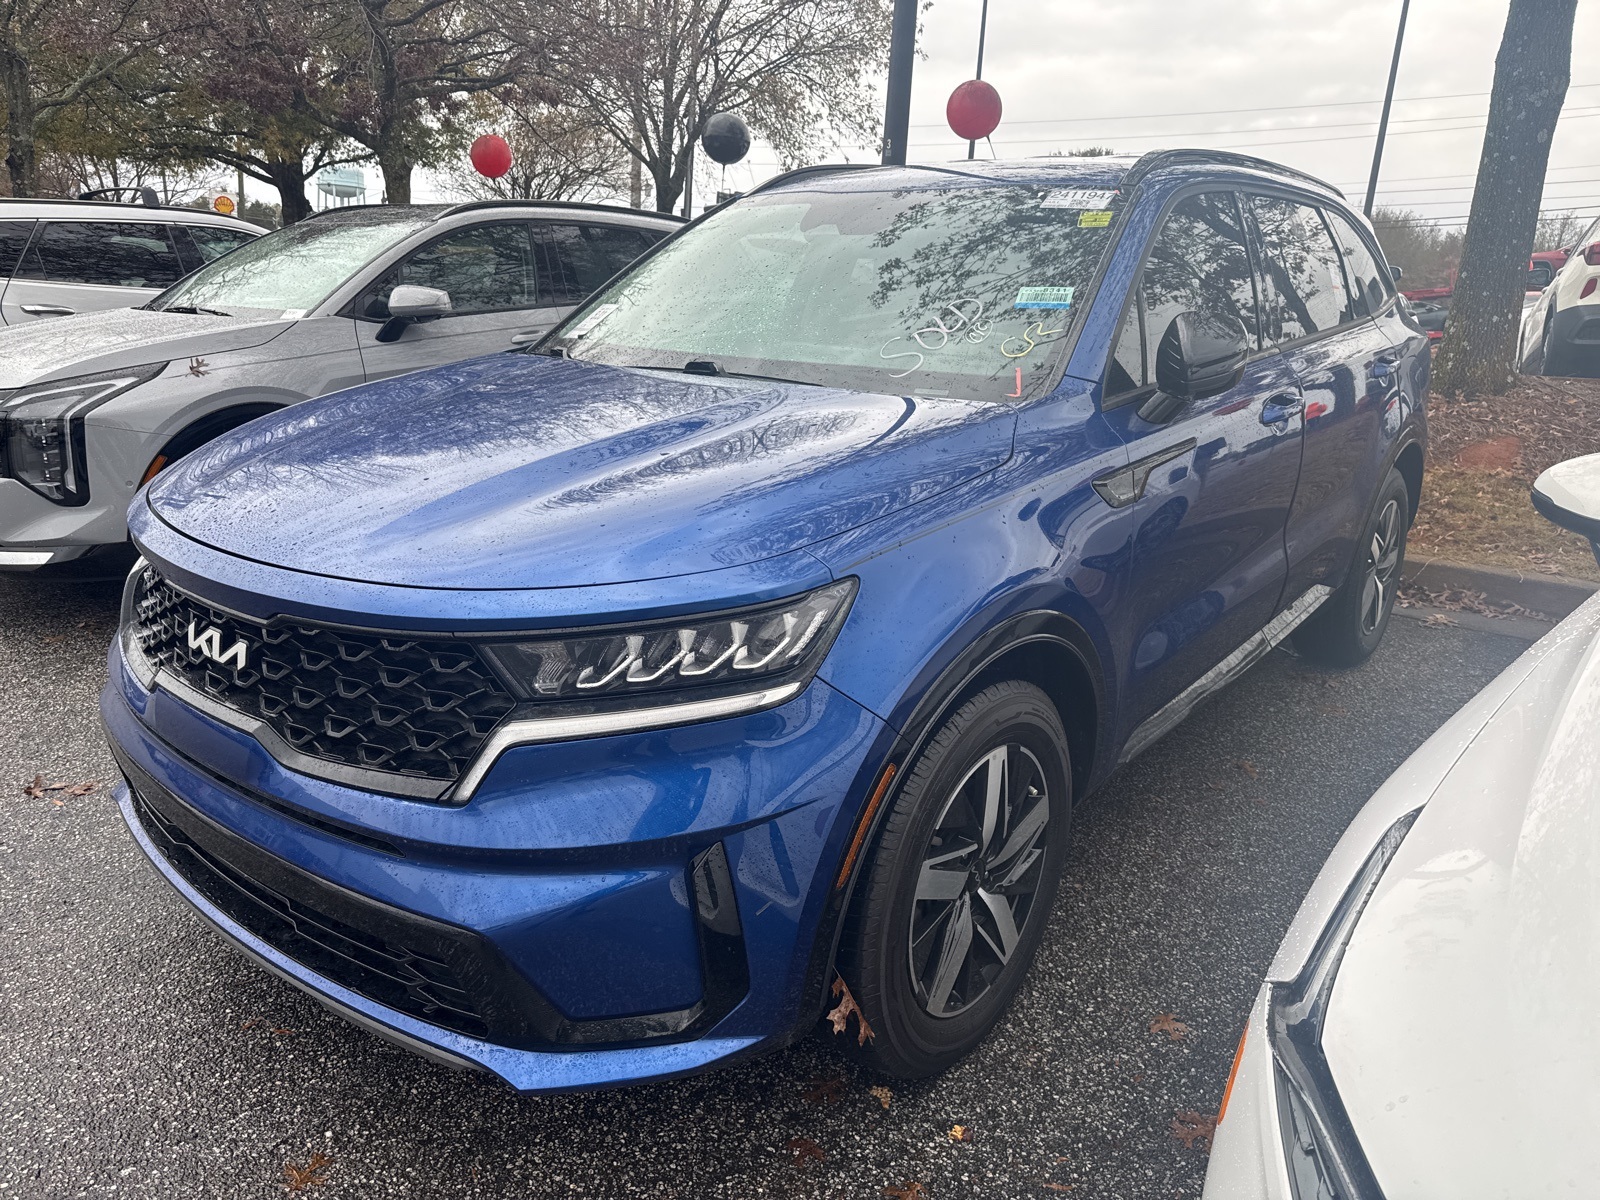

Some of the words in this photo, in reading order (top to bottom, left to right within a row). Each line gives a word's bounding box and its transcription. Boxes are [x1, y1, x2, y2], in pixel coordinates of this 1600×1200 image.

[886, 138, 892, 149] 3
[1050, 190, 1115, 200] 2411947
[879, 298, 984, 378] SOLD
[188, 621, 248, 671] KIA
